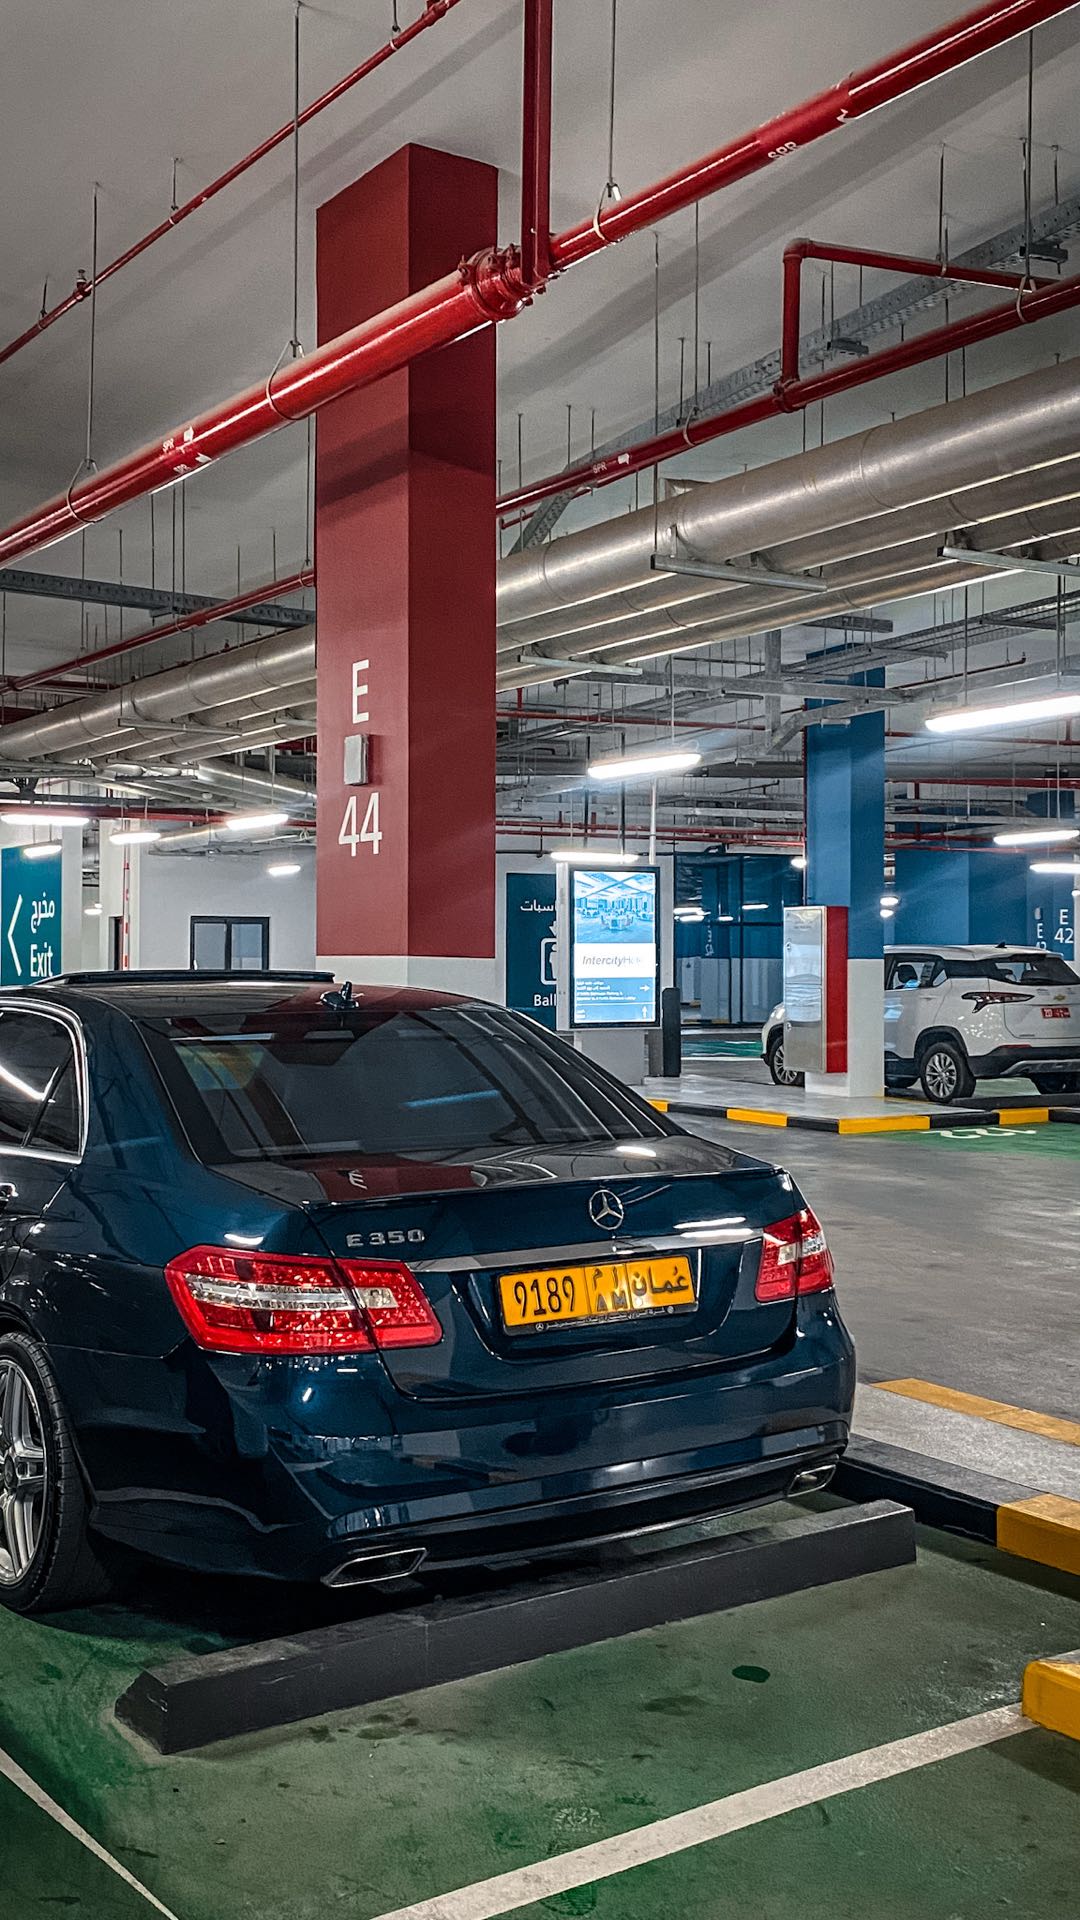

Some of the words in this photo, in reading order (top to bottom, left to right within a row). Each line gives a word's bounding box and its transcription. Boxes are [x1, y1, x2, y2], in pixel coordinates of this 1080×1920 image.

[592, 461, 608, 474] SPR
[352, 659, 370, 725] E
[338, 792, 383, 857] 44
[30, 891, 55, 934] مخرج
[1060, 909, 1069, 925] E
[1037, 923, 1044, 939] E
[1054, 928, 1074, 944] 42
[30, 941, 54, 977] Exit
[582, 955, 642, 968] IntercityH
[346, 1234, 364, 1247] E
[369, 1229, 425, 1245] 350
[514, 1275, 575, 1318] 9189
